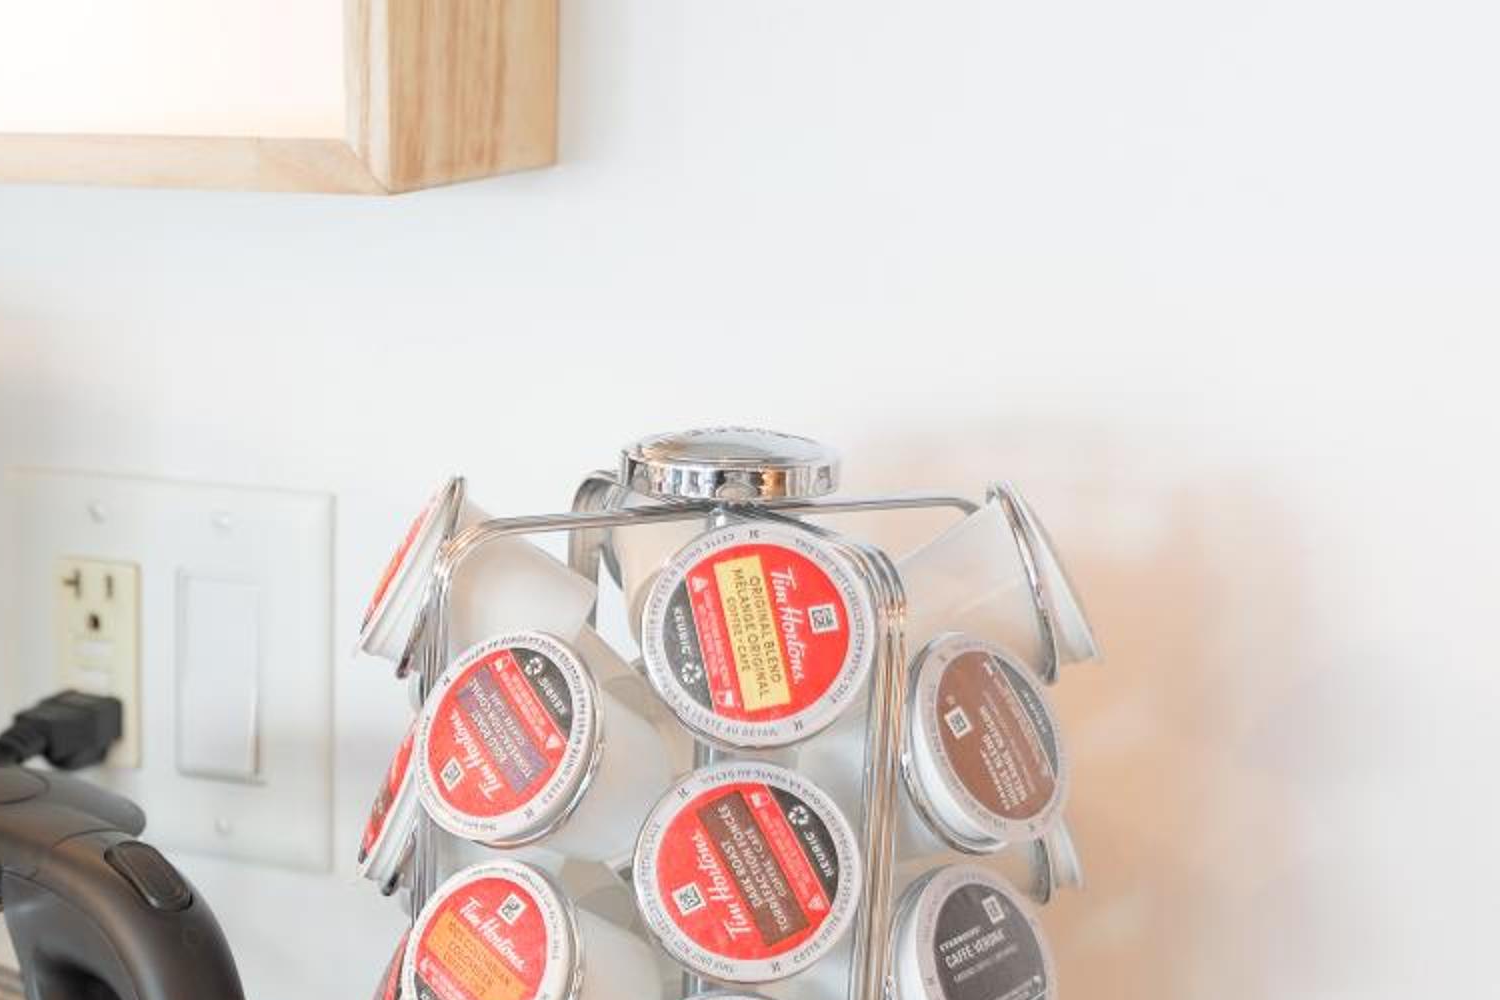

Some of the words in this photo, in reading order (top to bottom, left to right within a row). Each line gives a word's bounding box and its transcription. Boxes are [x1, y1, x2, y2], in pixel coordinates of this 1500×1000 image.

[769, 565, 798, 604] Tim
[672, 606, 692, 656] KEURIG
[725, 595, 743, 636] COFFEE
[731, 568, 757, 631] MÉLANGE
[746, 633, 770, 698] ORIGINAL
[747, 574, 772, 638] ORIGINAL
[763, 640, 783, 684] BLEND
[538, 674, 567, 717] KEURIG
[474, 762, 503, 804] Tim
[720, 838, 747, 876] ROAST
[804, 830, 834, 878] KEURIG
[456, 893, 486, 928] Tim
[739, 875, 763, 908] DARK
[717, 901, 752, 941] Tim
